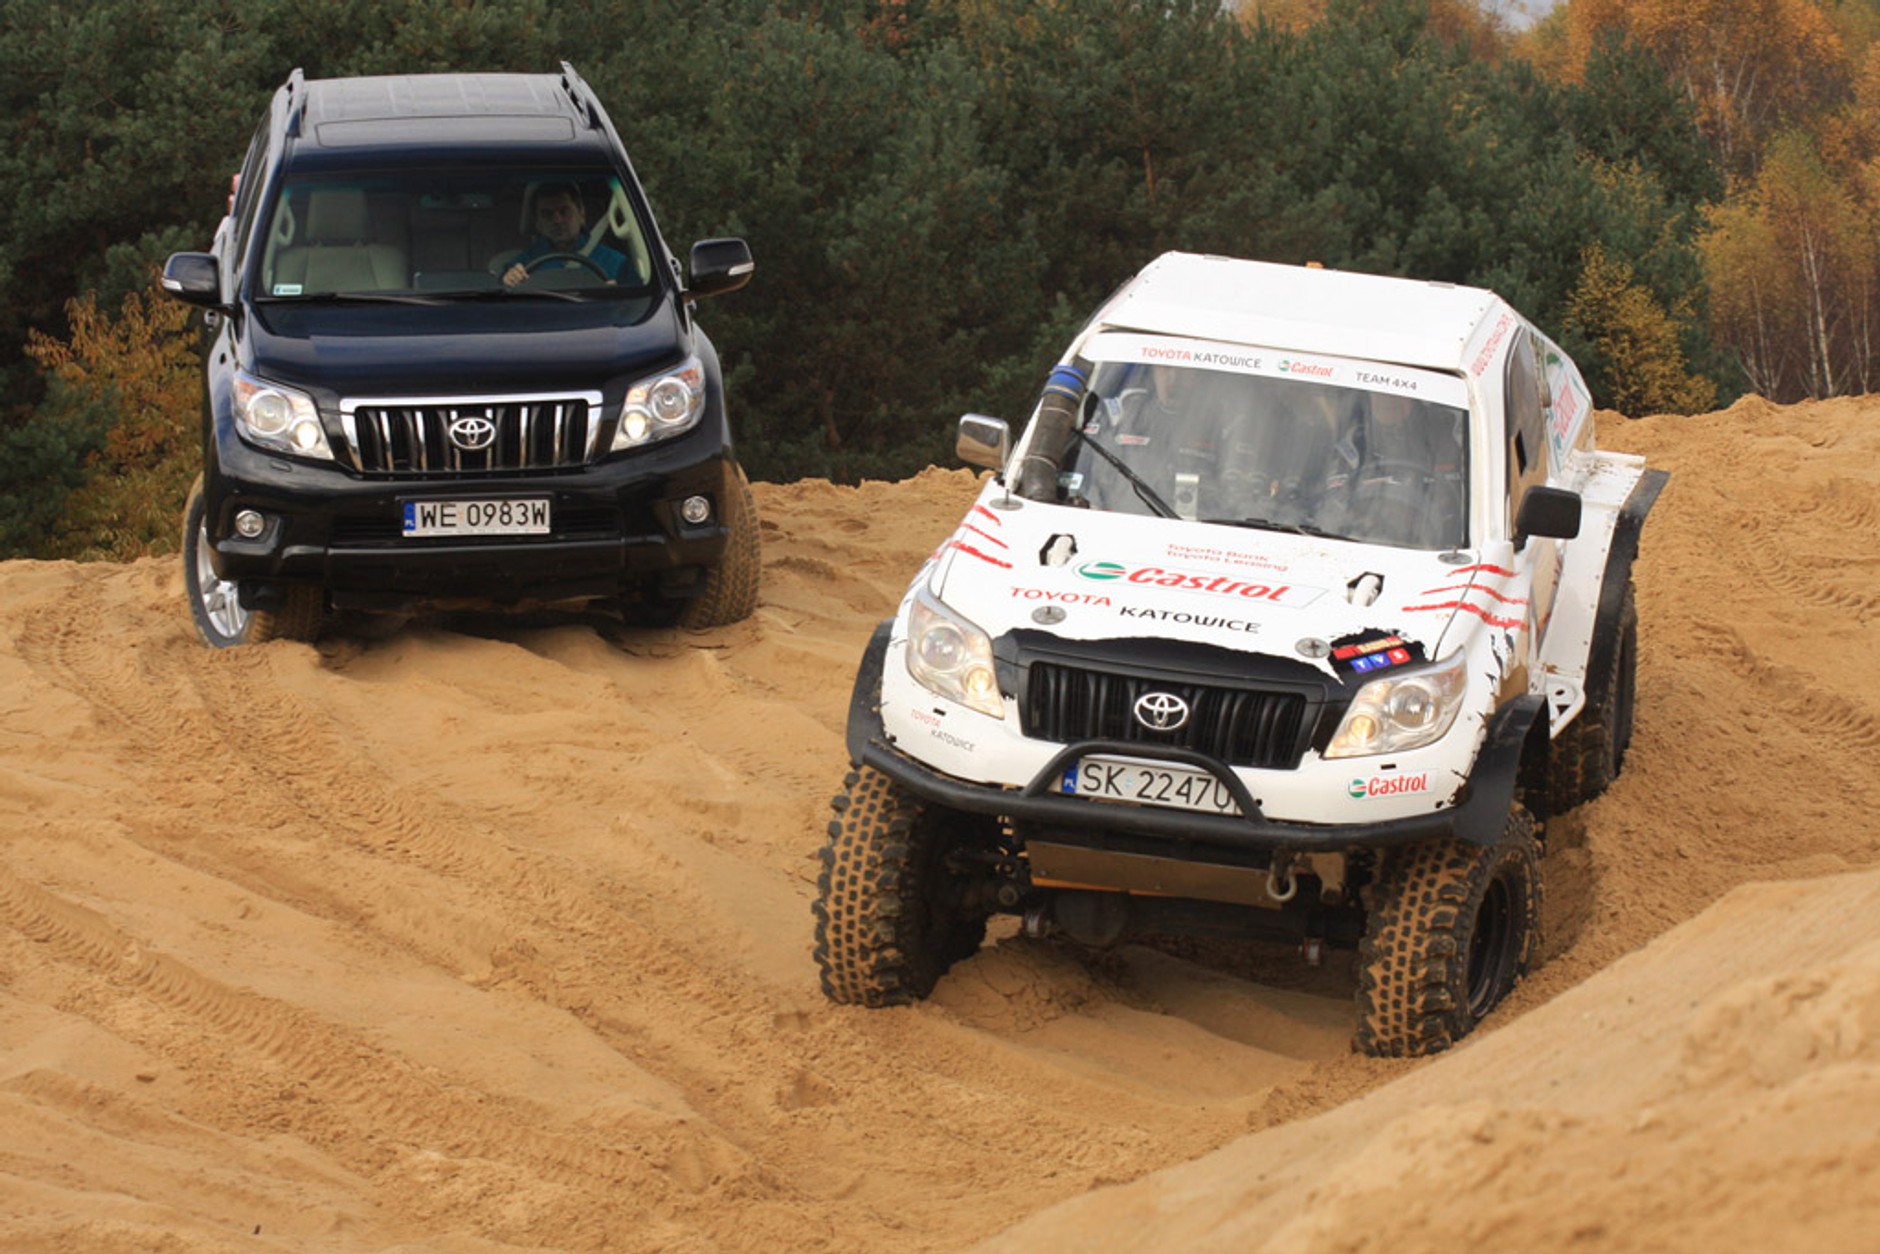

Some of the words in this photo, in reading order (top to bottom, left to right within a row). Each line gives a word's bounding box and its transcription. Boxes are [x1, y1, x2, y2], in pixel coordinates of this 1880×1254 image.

[1142, 347, 1191, 361] TOYOTA
[1193, 352, 1262, 368] KATOWICE
[1291, 361, 1334, 377] Castrol
[1356, 371, 1389, 385] TEAM
[420, 503, 457, 528] WE
[467, 502, 547, 527] 0983W
[1167, 550, 1221, 562] Toyota
[1168, 543, 1223, 556] Toyota
[1226, 551, 1269, 562] Bank
[1127, 567, 1291, 602] Castrol
[1010, 587, 1112, 607] TOYOTA
[1119, 606, 1262, 634] KATOWICE
[911, 708, 941, 728] TOYOTA
[931, 728, 976, 752] KATOWICE
[1082, 763, 1126, 797] SK
[1368, 773, 1428, 796] Castrol
